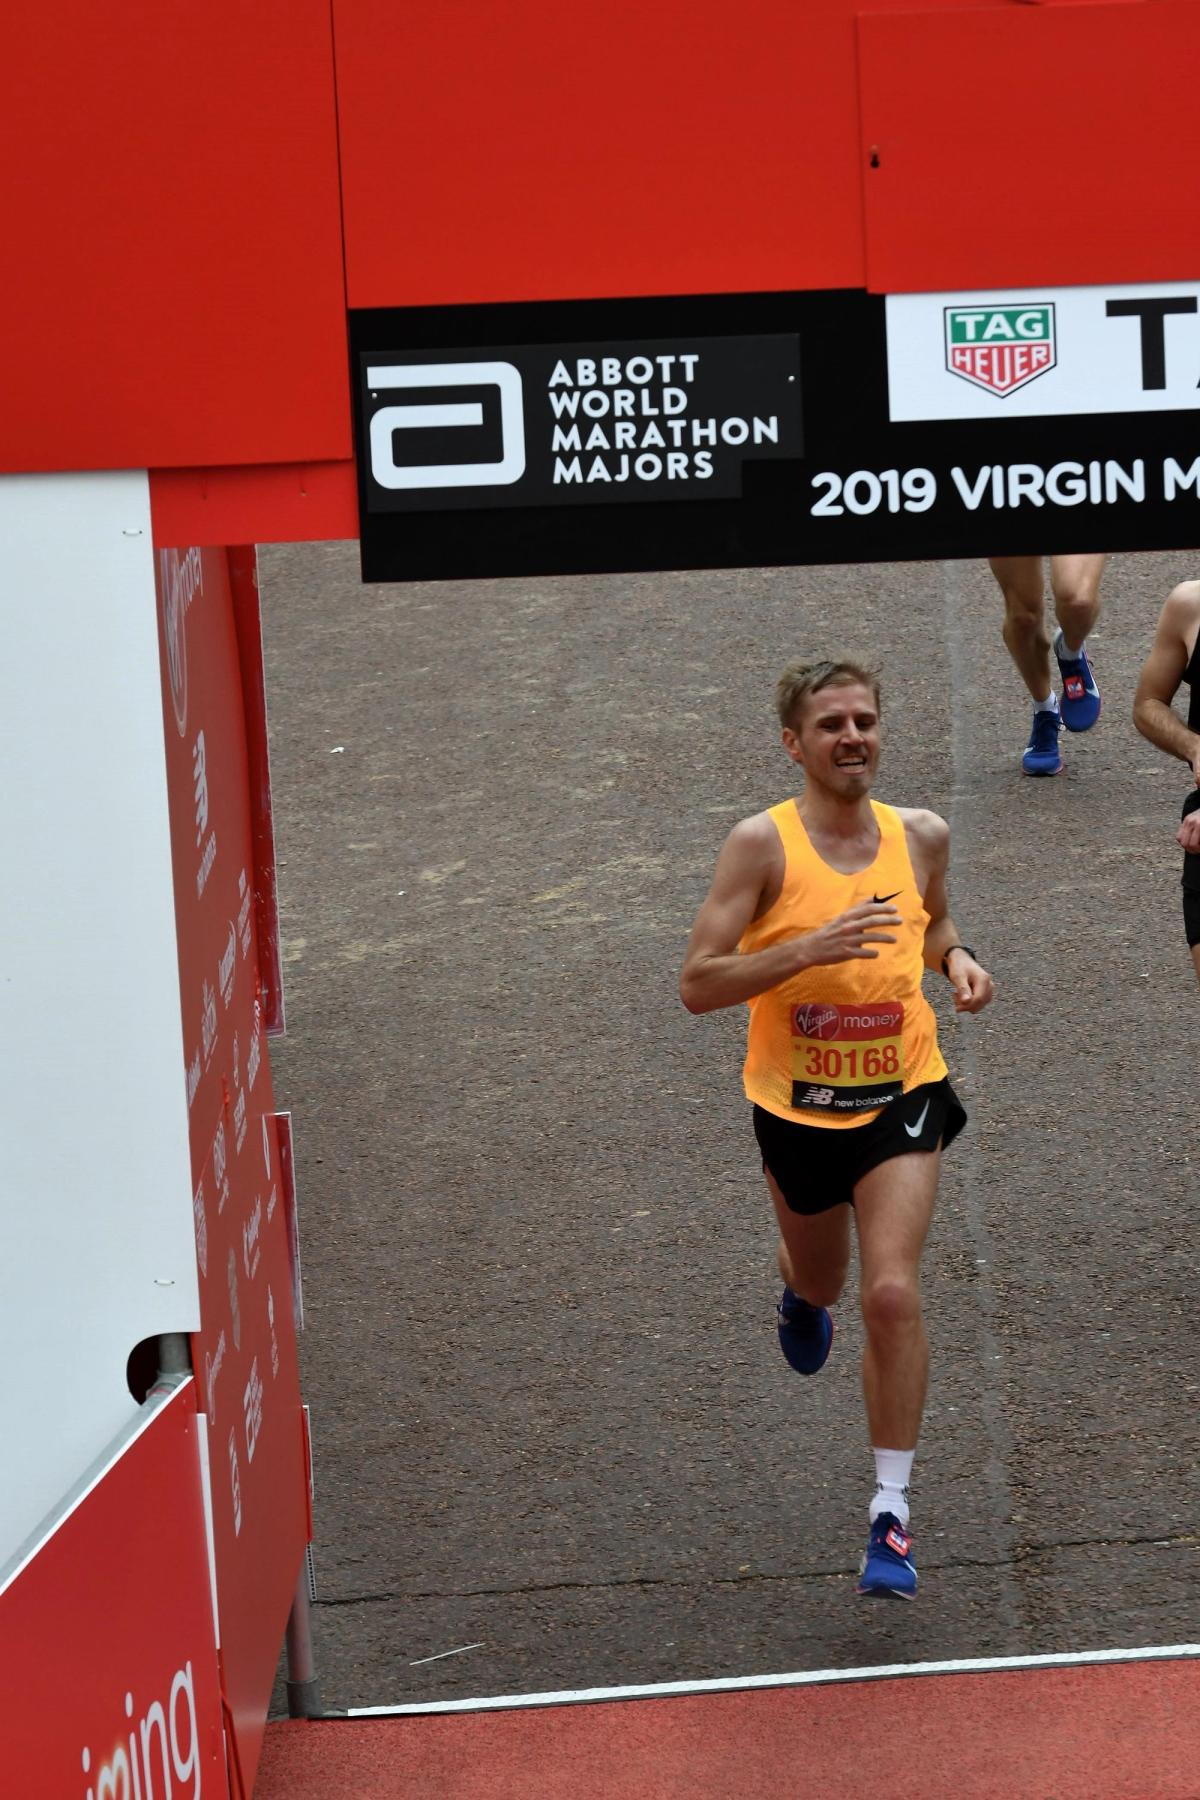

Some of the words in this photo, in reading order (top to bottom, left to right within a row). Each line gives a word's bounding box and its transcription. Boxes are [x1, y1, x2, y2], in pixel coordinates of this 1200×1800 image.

[955, 312, 1044, 341] TAG
[1106, 297, 1200, 390] T
[549, 355, 699, 387] ABBOTT
[955, 346, 1048, 388] HEUER
[549, 388, 687, 418] WORLD
[552, 416, 778, 451] MARATHON
[553, 451, 713, 483] MAJORS
[811, 468, 936, 516] 2019
[951, 459, 1144, 510] VIRGIN
[798, 1004, 837, 1037] Virgin
[844, 1014, 900, 1028] money
[805, 1045, 900, 1078] 30168
[856, 1095, 894, 1107] balance
